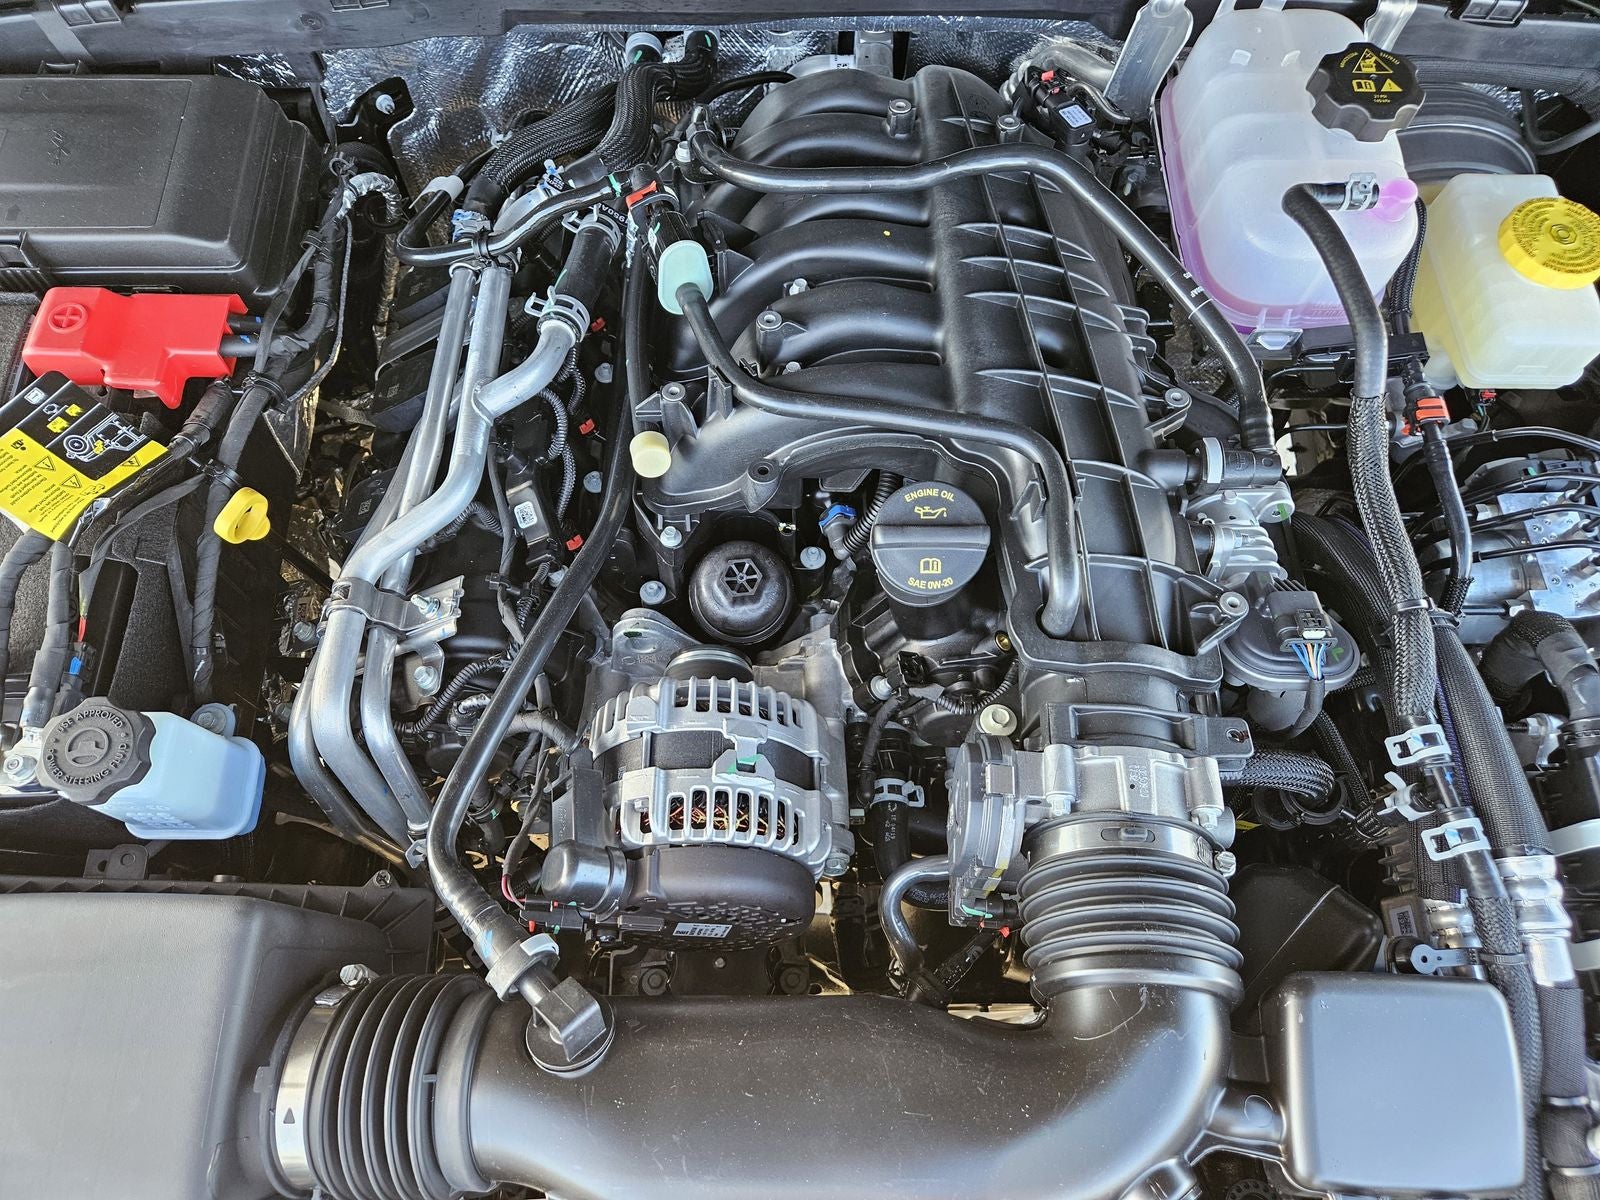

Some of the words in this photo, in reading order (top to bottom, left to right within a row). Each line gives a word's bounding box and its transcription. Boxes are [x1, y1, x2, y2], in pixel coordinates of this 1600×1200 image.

[904, 488, 940, 502] ENGINE
[941, 489, 955, 502] OIL
[907, 577, 926, 589] SAE
[927, 577, 954, 589] 0W-20
[58, 718, 75, 733] USE
[76, 709, 125, 729] APPROVED
[46, 748, 65, 777] POWER
[63, 768, 112, 785] STEERING
[110, 743, 130, 769] FLUID
